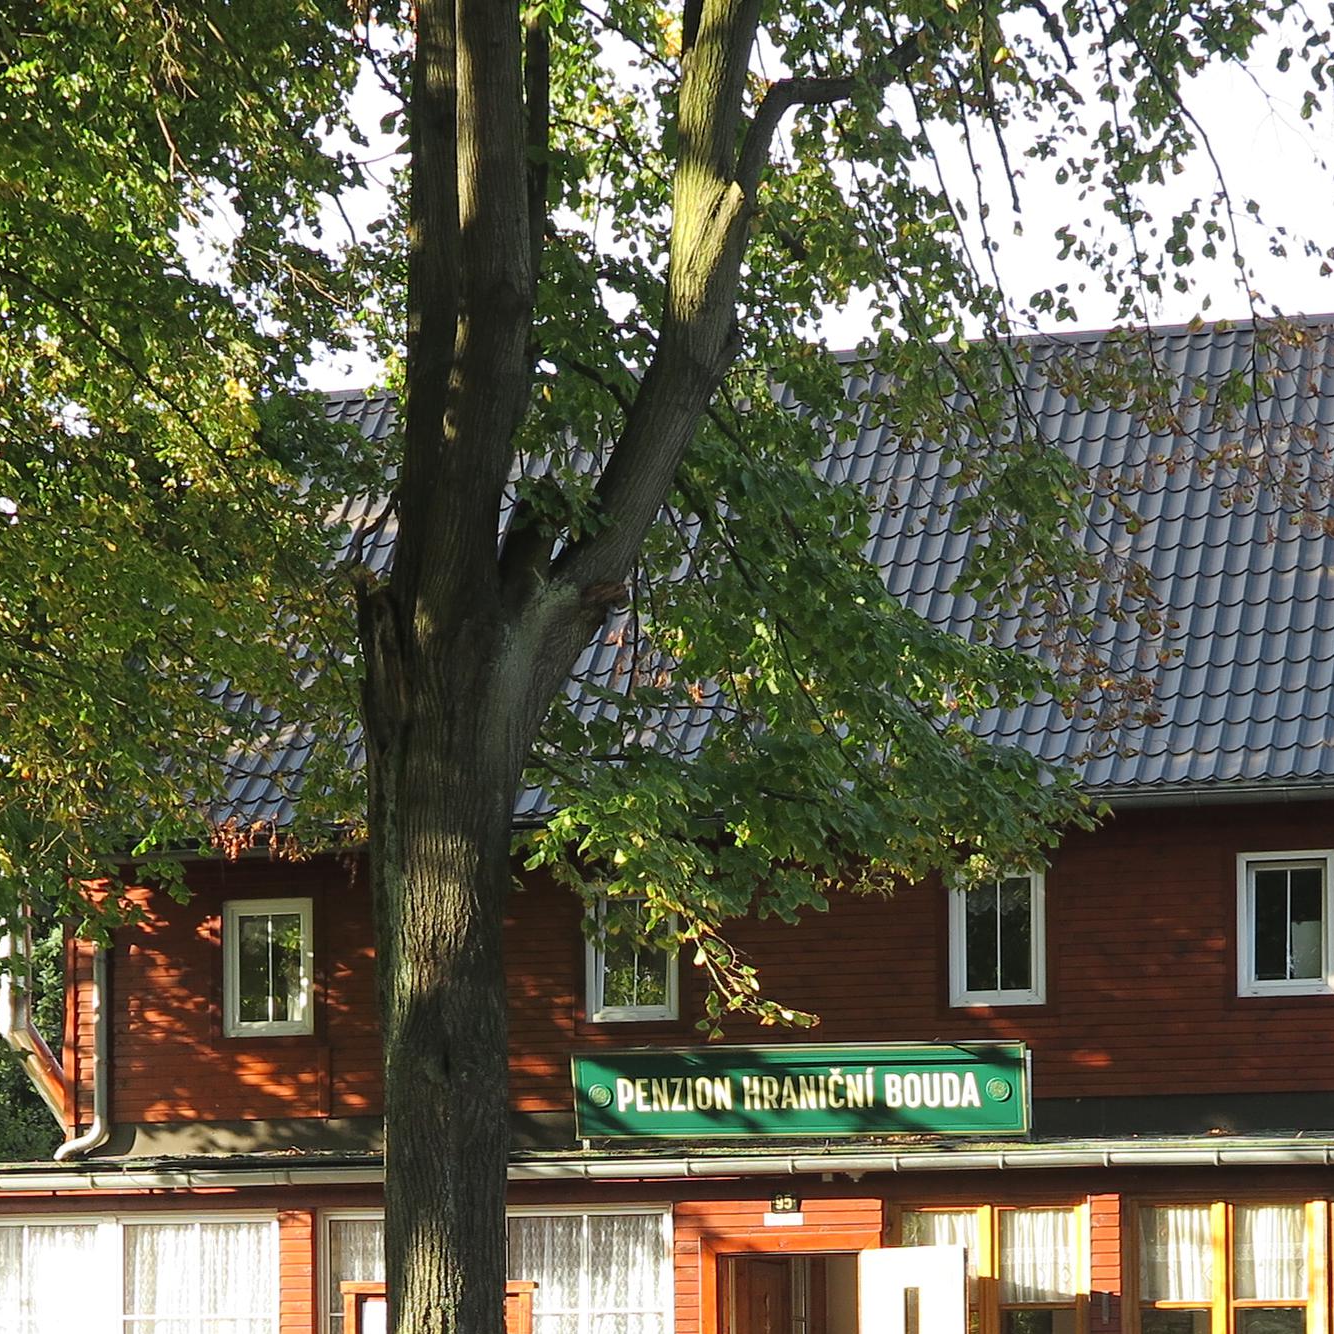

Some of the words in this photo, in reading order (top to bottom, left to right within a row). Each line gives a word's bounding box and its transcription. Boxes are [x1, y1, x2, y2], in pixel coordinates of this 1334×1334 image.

[616, 1076, 733, 1112] PENZION
[742, 1066, 875, 1111] HRANIČNÍ
[884, 1071, 982, 1109] BOUDA
[775, 1194, 793, 1210] 95
